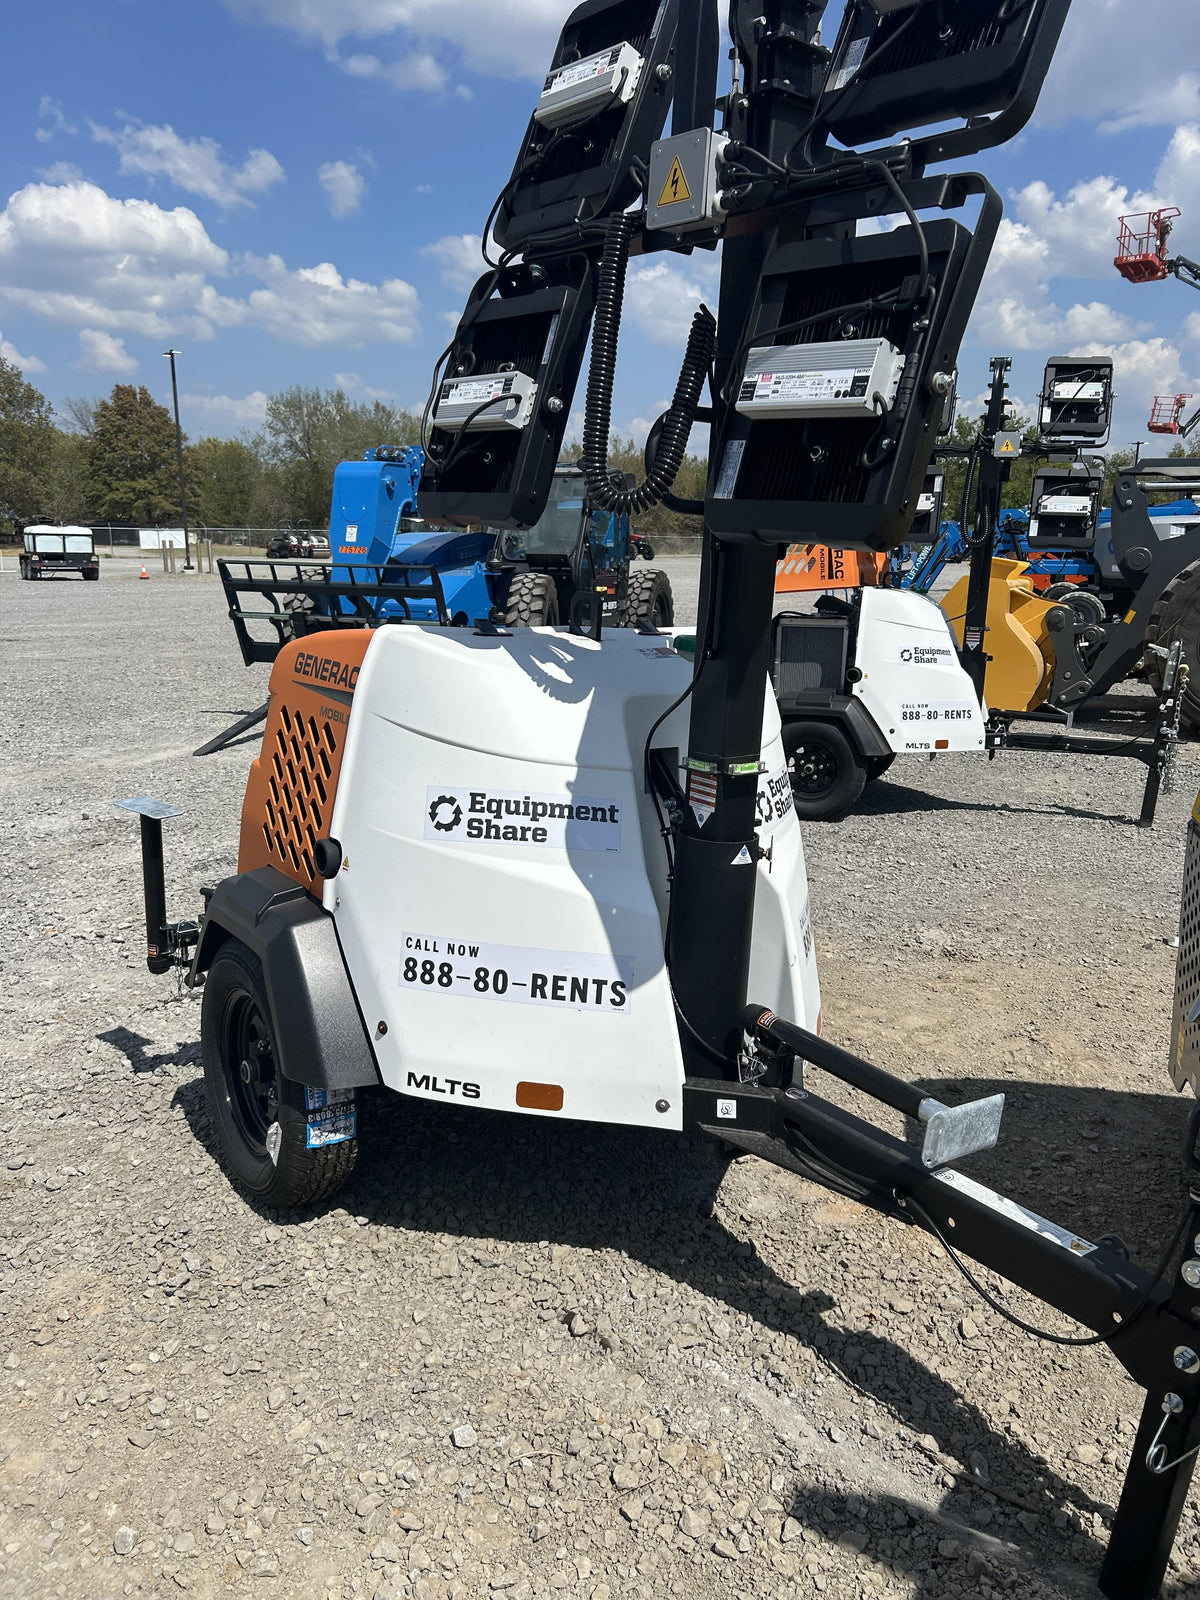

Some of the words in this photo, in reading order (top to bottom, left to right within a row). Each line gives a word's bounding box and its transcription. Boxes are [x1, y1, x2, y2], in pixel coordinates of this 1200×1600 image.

[340, 546, 367, 554] 775726
[294, 652, 361, 690] GENERAC
[913, 656, 938, 664] Share
[901, 709, 972, 721] 888-80-RENTS
[905, 742, 931, 750] MLTS
[468, 792, 619, 824] Equipment
[466, 817, 548, 843] Share
[405, 936, 440, 953] CALL
[446, 942, 480, 958] NOW
[402, 956, 628, 1007] 888-80-RENTS
[406, 1071, 481, 1099] MLTS
